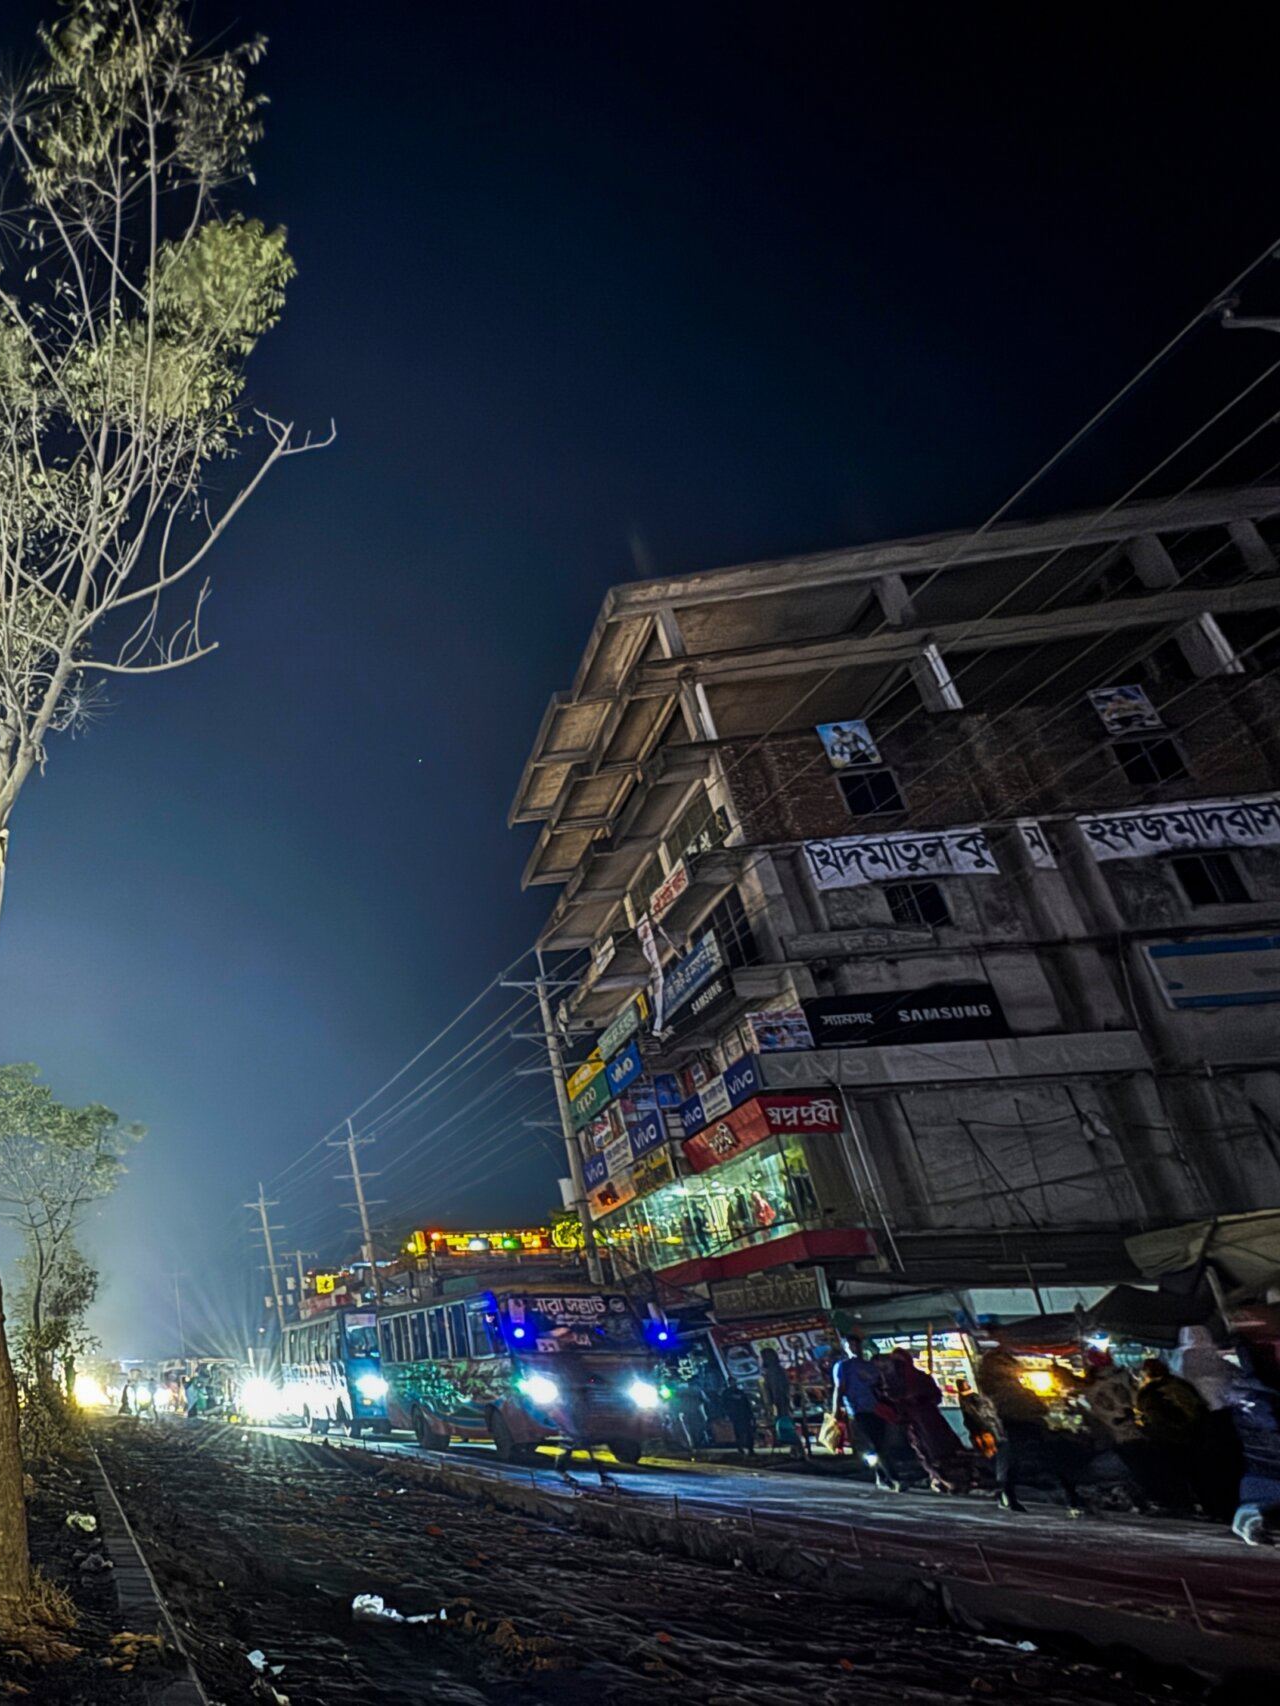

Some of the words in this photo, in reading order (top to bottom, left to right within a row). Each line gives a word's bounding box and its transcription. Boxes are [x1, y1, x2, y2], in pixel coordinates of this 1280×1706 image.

[691, 980, 723, 1016] SAMSUNG
[897, 1003, 993, 1023] SAMSUNG
[611, 1057, 634, 1083] vivo
[728, 1069, 754, 1096] vivo
[681, 1105, 703, 1128] vivo
[634, 1123, 657, 1149] vivo
[586, 1162, 605, 1183] vivo
